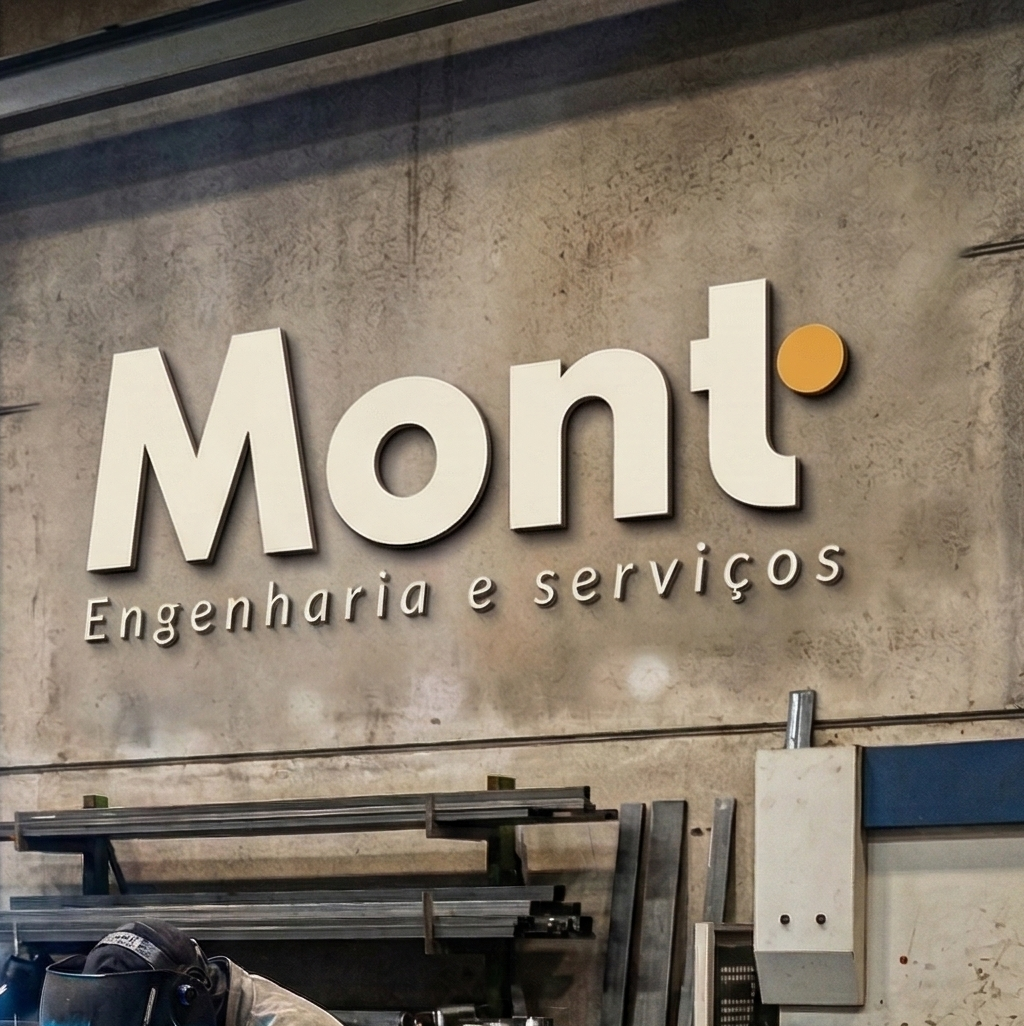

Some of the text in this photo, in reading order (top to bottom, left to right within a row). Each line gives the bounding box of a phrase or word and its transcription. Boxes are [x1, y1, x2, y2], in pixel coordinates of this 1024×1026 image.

[86, 277, 800, 573] Mont
[83, 541, 843, 645] Engenharia e serviços
